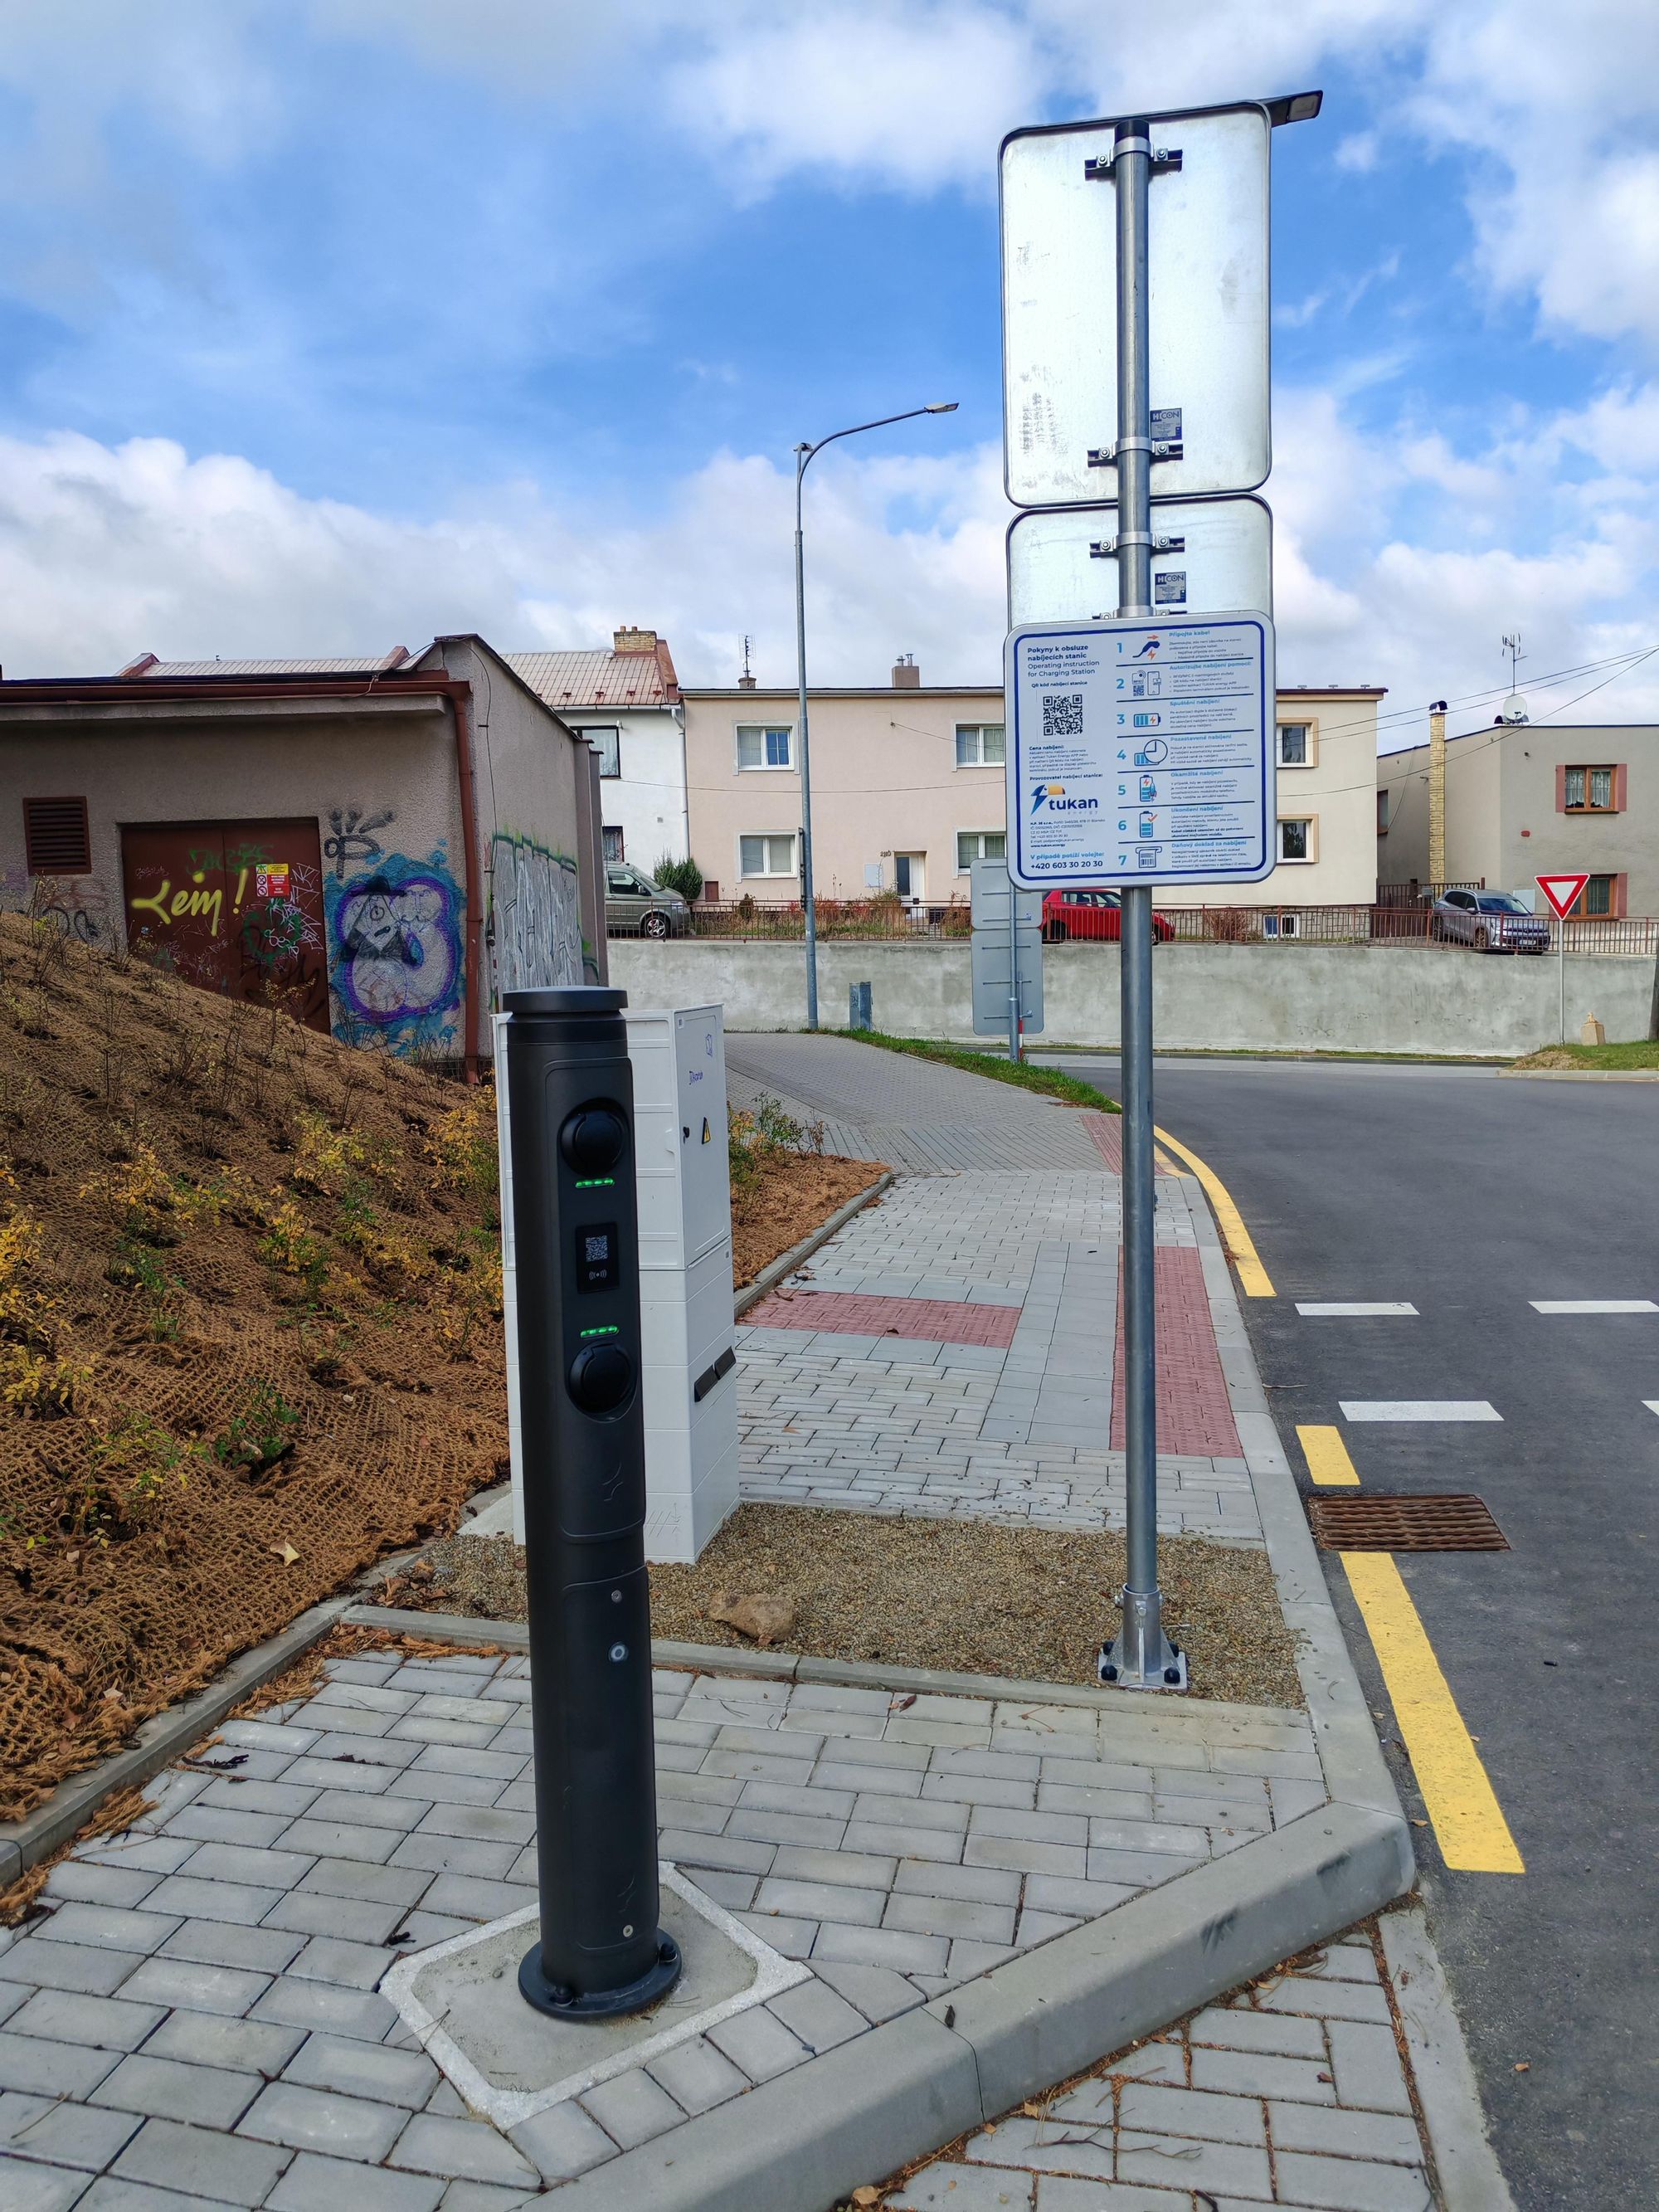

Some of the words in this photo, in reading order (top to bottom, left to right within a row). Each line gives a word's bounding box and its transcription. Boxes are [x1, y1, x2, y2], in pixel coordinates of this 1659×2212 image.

[1117, 643, 1122, 653] 1
[1116, 679, 1125, 689] 2
[1117, 714, 1125, 725] 3
[1117, 750, 1126, 760] 4
[1118, 785, 1126, 795] 5
[1049, 798, 1098, 810] tukan
[1118, 820, 1127, 830] 6
[1118, 855, 1127, 866] 7
